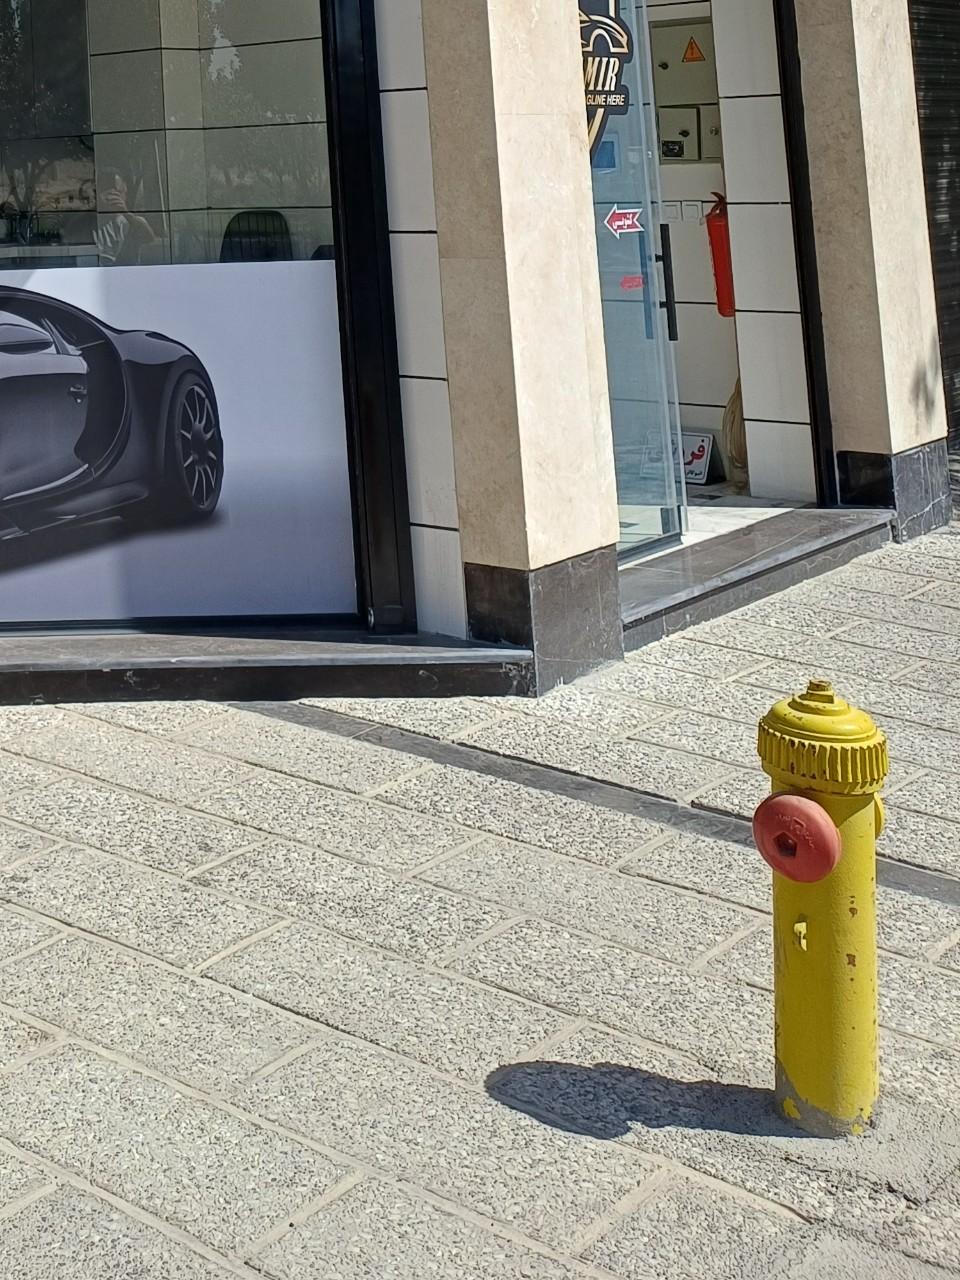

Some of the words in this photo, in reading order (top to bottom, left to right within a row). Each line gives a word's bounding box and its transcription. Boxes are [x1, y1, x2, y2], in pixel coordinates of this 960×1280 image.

[583, 56, 620, 91] MIR
[586, 94, 607, 106] GLINE
[606, 94, 626, 106] HERE
